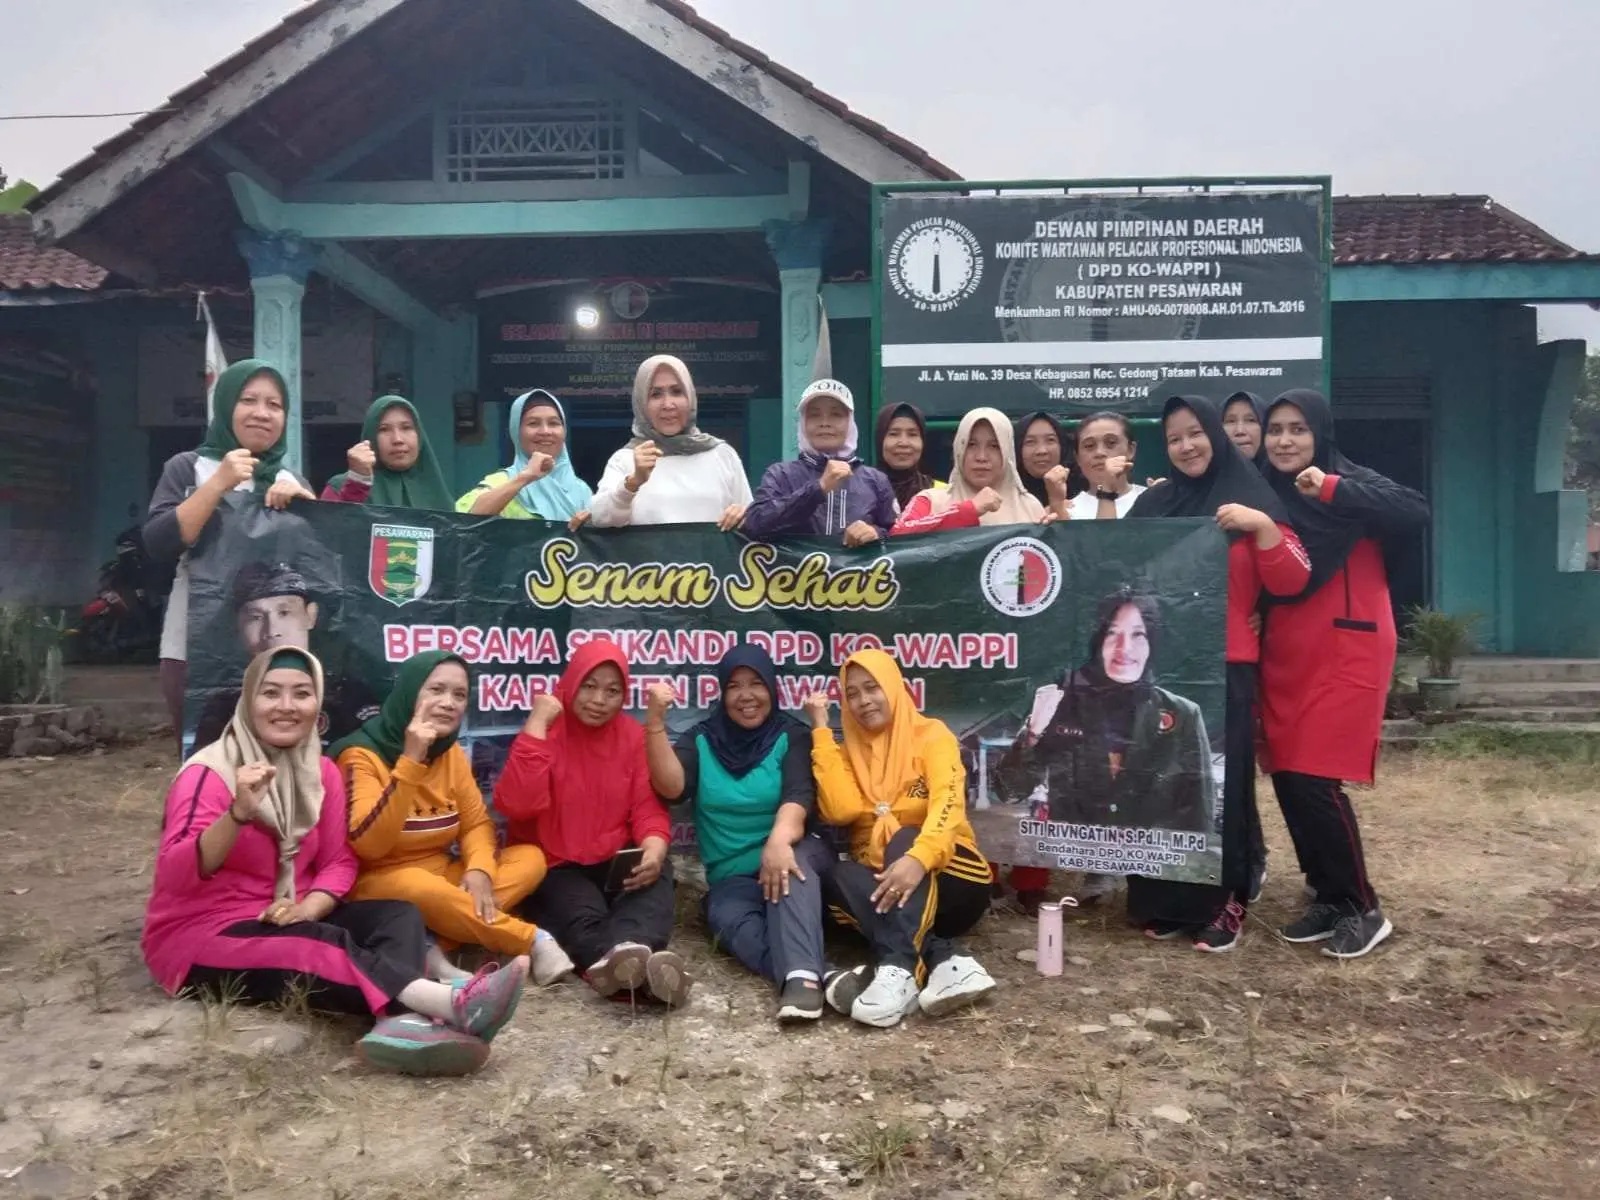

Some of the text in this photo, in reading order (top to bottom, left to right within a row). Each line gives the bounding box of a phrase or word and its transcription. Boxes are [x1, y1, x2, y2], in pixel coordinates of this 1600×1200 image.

[1035, 218, 1264, 238] DEWAN PIMPINAN DAERAH
[995, 237, 1303, 259] KOMITE WARTAWAN PELACAK PROFESIONAL INDONESIA
[1088, 263, 1122, 278] DPD
[1127, 262, 1210, 277] KO-WAPPI
[1055, 282, 1243, 300] KABUPATEN PESAWARAN
[995, 306, 1061, 318] Menkumham
[1064, 305, 1075, 317] RI
[1078, 304, 1113, 317] Nomor
[933, 371, 945, 381] A.
[947, 370, 969, 381] Yani
[971, 370, 989, 381] No.
[991, 369, 1004, 381] 39
[1006, 369, 1032, 380] Desa
[1034, 368, 1091, 382] Kebagusan
[1093, 368, 1116, 379] Kec.
[1119, 367, 1158, 380] Gedong
[1160, 366, 1197, 378] Tataan
[1199, 366, 1223, 377] Kab.
[1225, 365, 1283, 377] Pesawaran
[1049, 386, 1149, 399] HP. 0852 6954 1214
[374, 527, 433, 540] PESAWARAN
[526, 537, 900, 612] Senam Sehat
[384, 624, 562, 665] BERSAMA
[478, 674, 689, 711] KABTEN
[1020, 820, 1046, 836] SITI
[1172, 833, 1206, 850] M.Pd
[1038, 841, 1186, 864] Bendahara DPD KO WAPPI
[1059, 857, 1162, 875] KAB PESAWARAN
